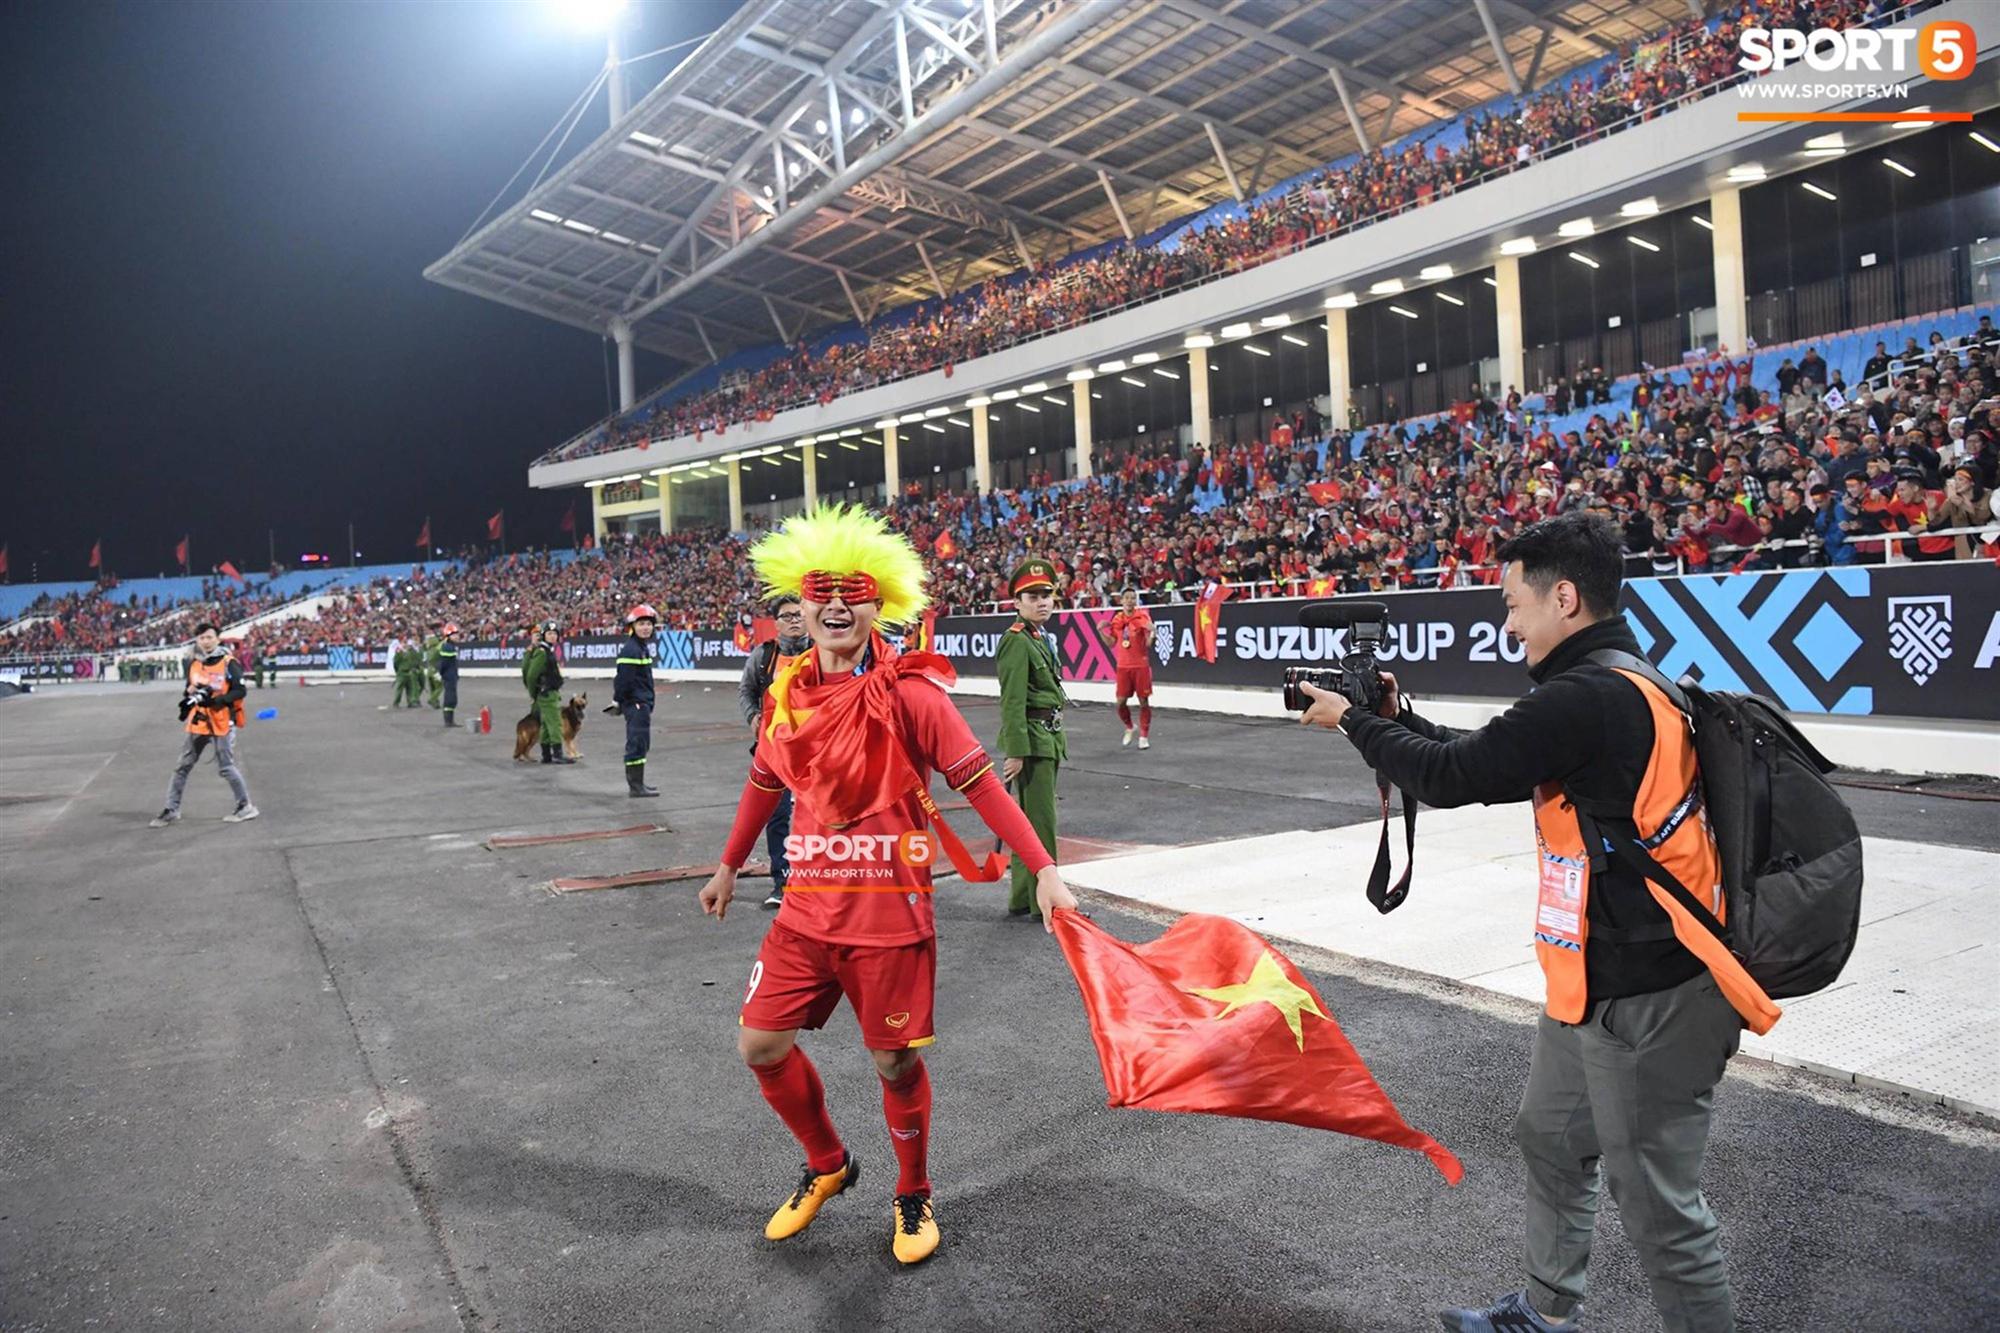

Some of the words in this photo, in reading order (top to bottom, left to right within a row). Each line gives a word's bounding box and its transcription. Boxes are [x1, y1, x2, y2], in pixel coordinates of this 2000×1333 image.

[571, 645, 586, 658] AFF
[586, 643, 618, 659] SUZUKI
[702, 640, 722, 657] AFF
[933, 633, 968, 657] ZUKI
[970, 632, 1000, 658] CU
[1178, 626, 1227, 658] AF
[1235, 625, 1352, 661] SUZUK
[1468, 621, 1528, 663] 20
[744, 960, 764, 1004] 9
